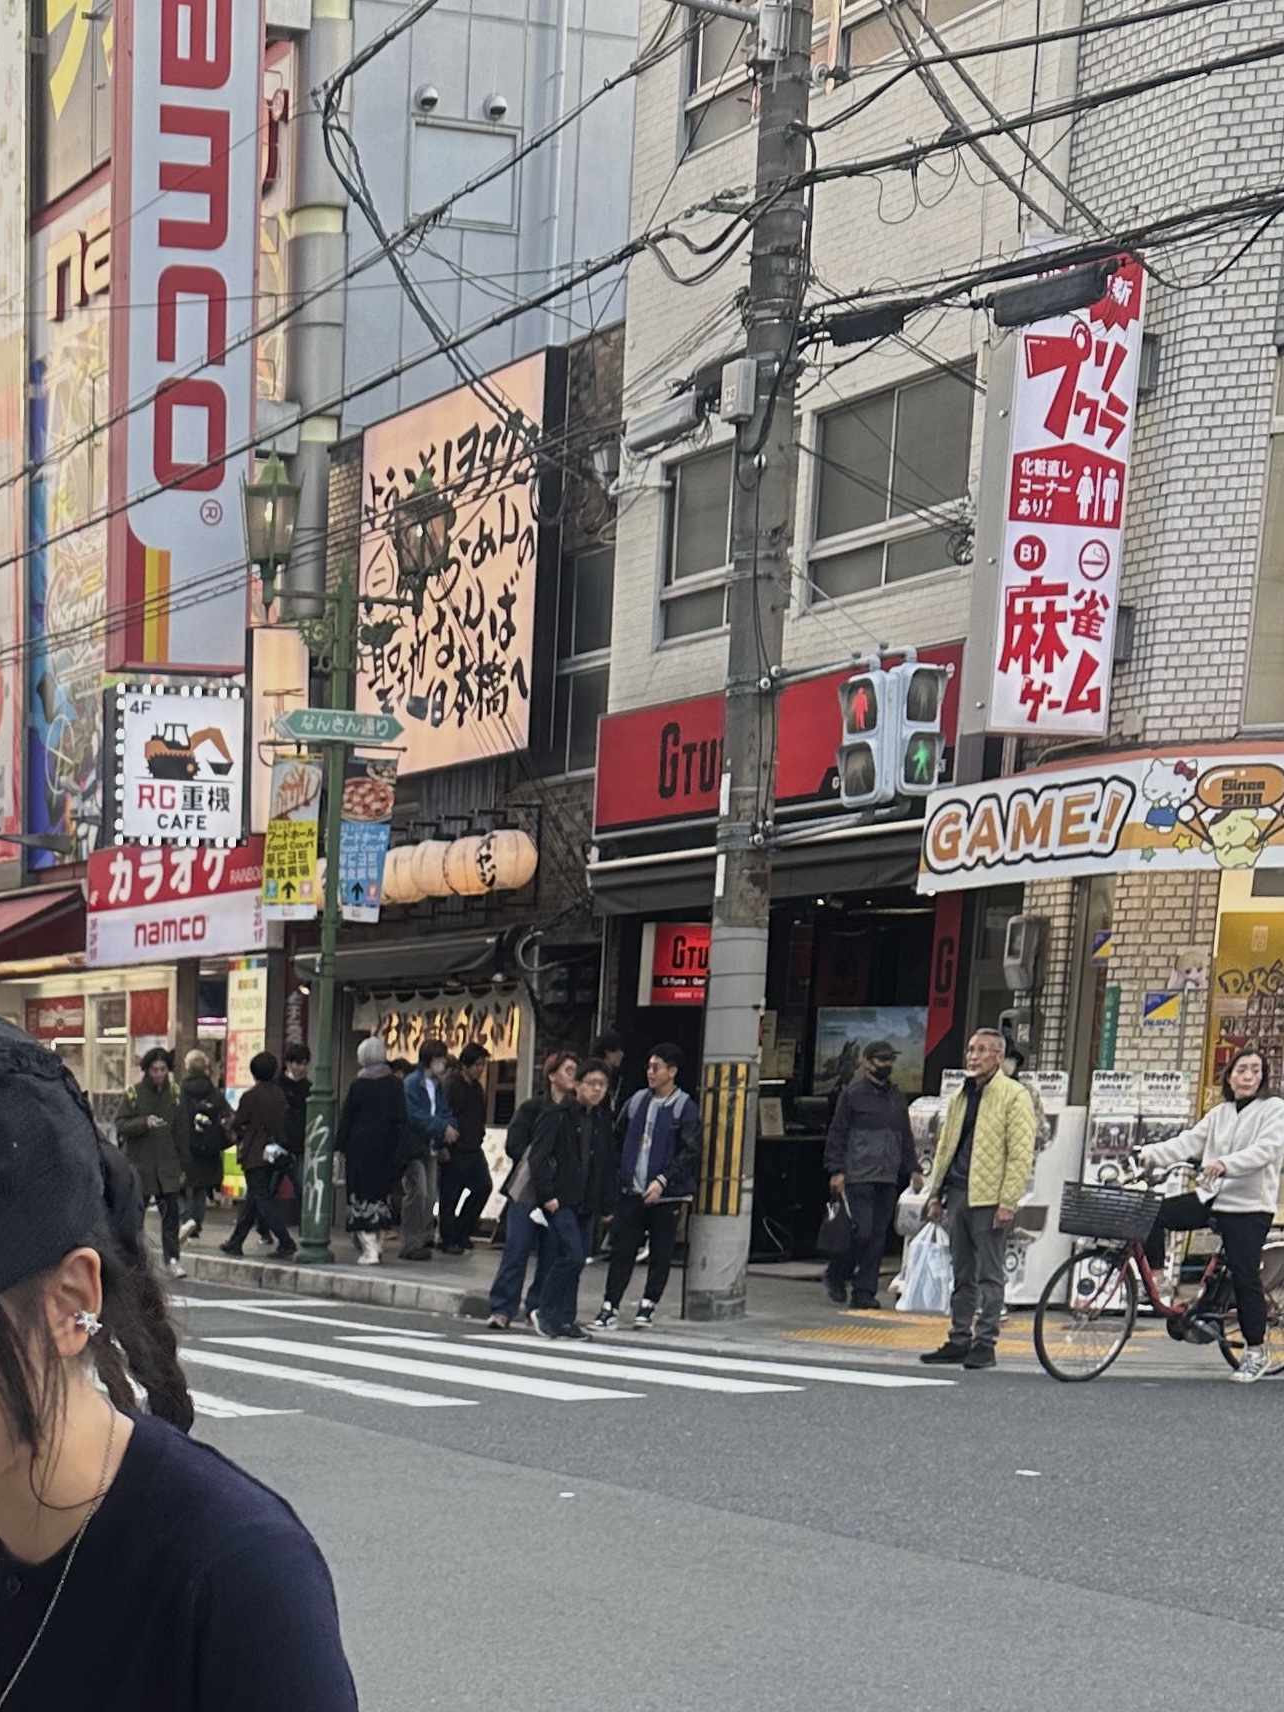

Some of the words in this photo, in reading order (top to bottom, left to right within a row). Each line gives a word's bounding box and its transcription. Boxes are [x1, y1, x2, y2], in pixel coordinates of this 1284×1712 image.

[1024, 319, 1129, 450] プリクラ
[1020, 457, 1074, 479] 化粧直し
[1018, 478, 1071, 496] コーナー
[1017, 498, 1054, 518] あり!
[1019, 544, 1041, 563] B1
[997, 576, 1110, 675] 麻雀
[1019, 649, 1102, 723] ゲーム
[129, 700, 152, 715] 4F
[301, 713, 390, 737] なんさん通り
[658, 721, 725, 799] GTU
[157, 814, 207, 831] CAFE
[932, 786, 1126, 862] GAME!
[108, 845, 231, 905] カラオケ
[229, 866, 263, 885] RAINBO
[134, 914, 206, 948] namco
